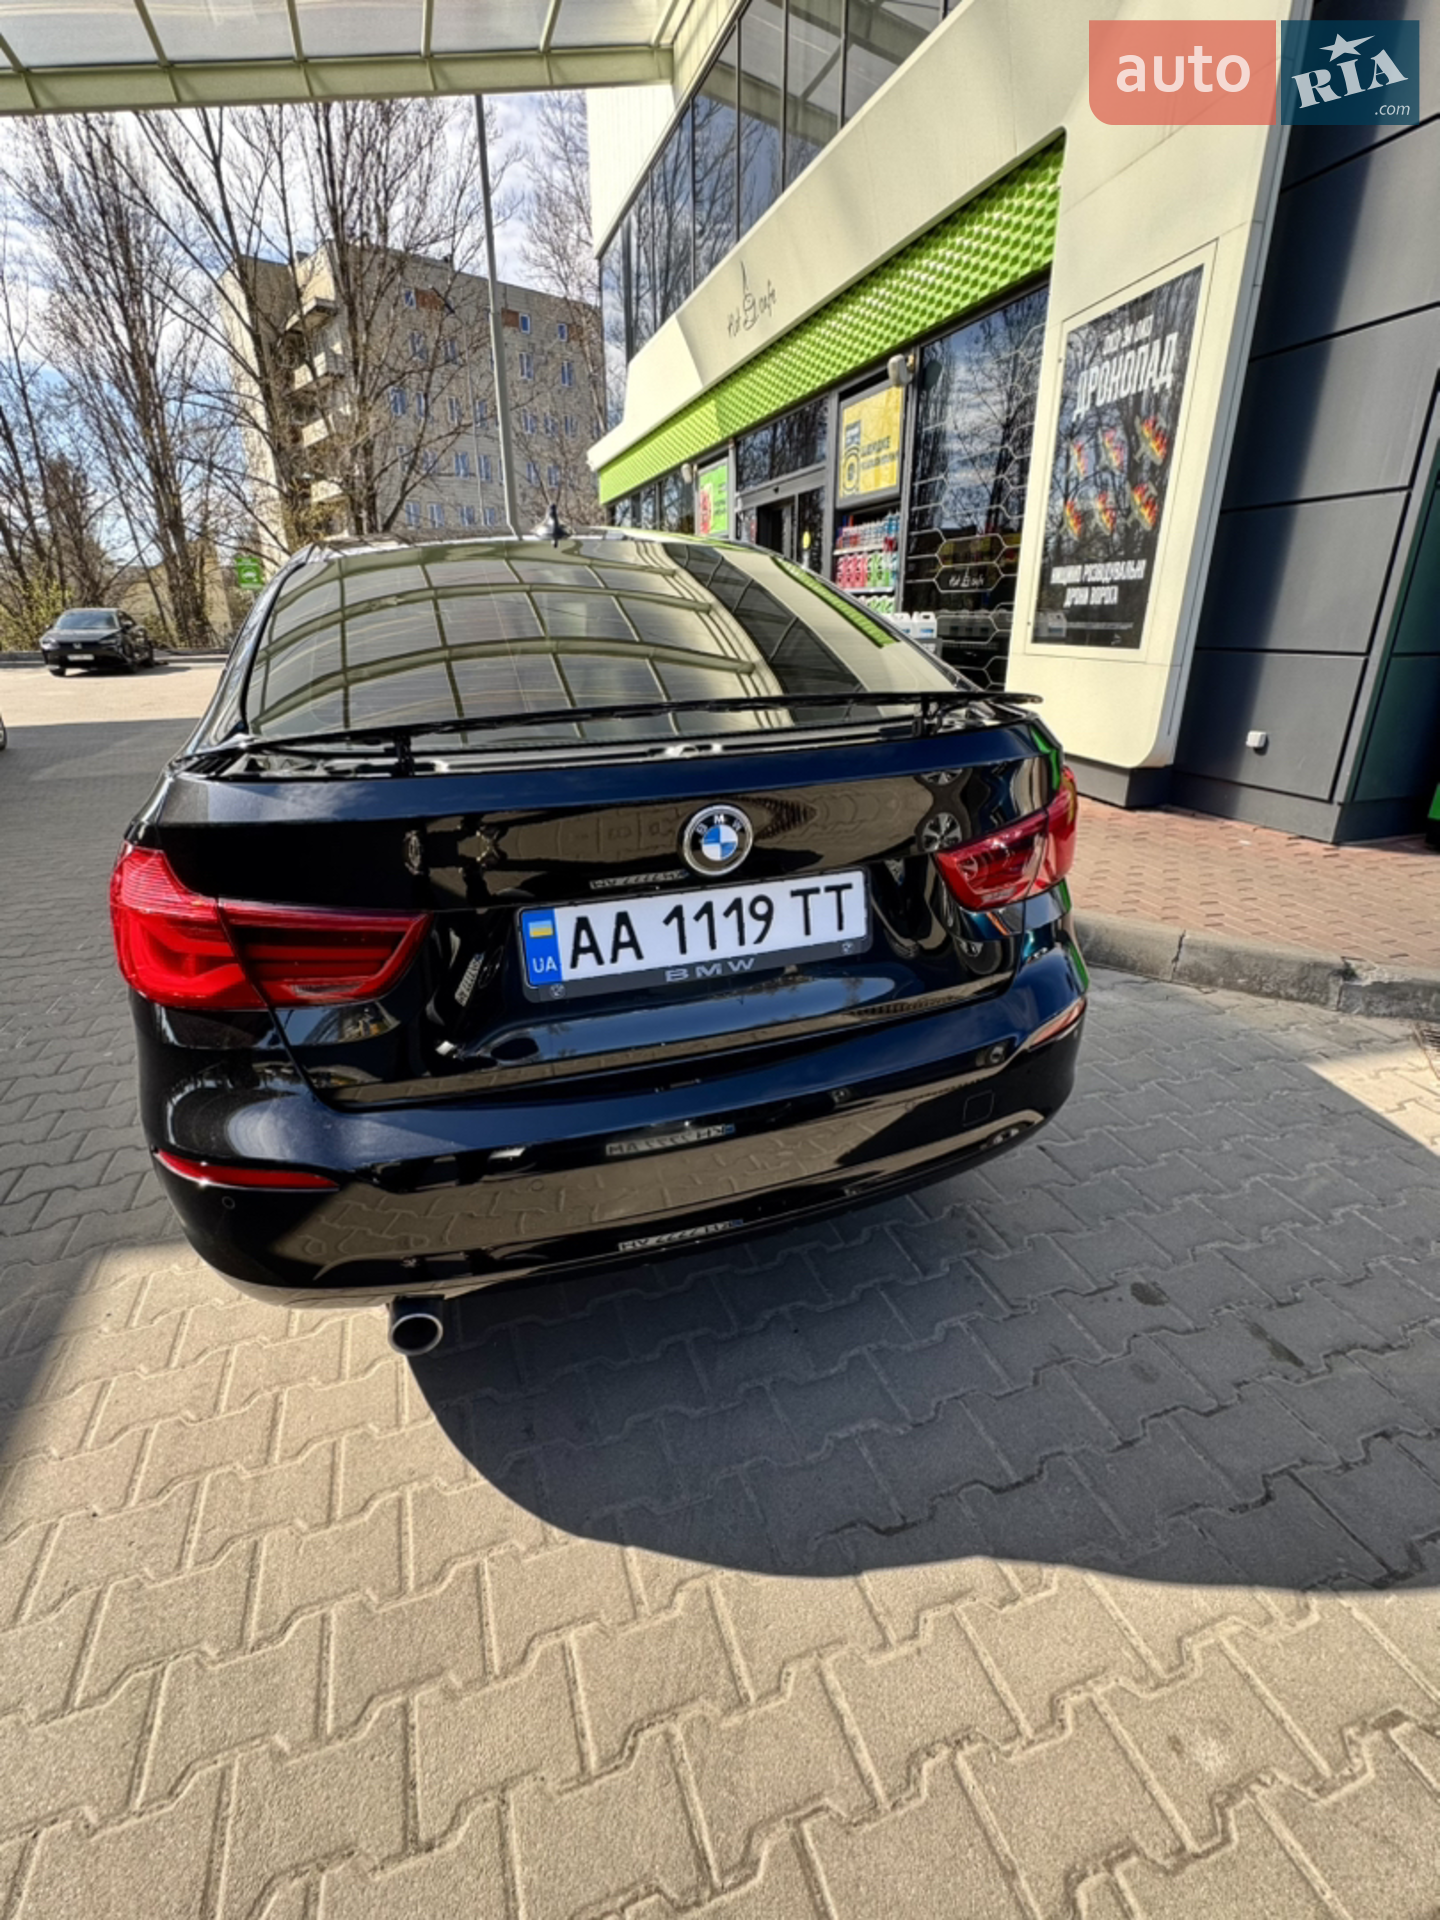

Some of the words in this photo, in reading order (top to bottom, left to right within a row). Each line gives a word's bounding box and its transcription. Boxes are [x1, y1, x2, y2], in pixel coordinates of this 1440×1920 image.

[1071, 331, 1179, 422] ДРОНОПАД
[695, 813, 743, 836] BMW
[570, 911, 644, 969] AA
[662, 894, 774, 955] 1119
[790, 883, 853, 936] TT
[532, 955, 558, 973] UA
[665, 957, 755, 982] BMW
